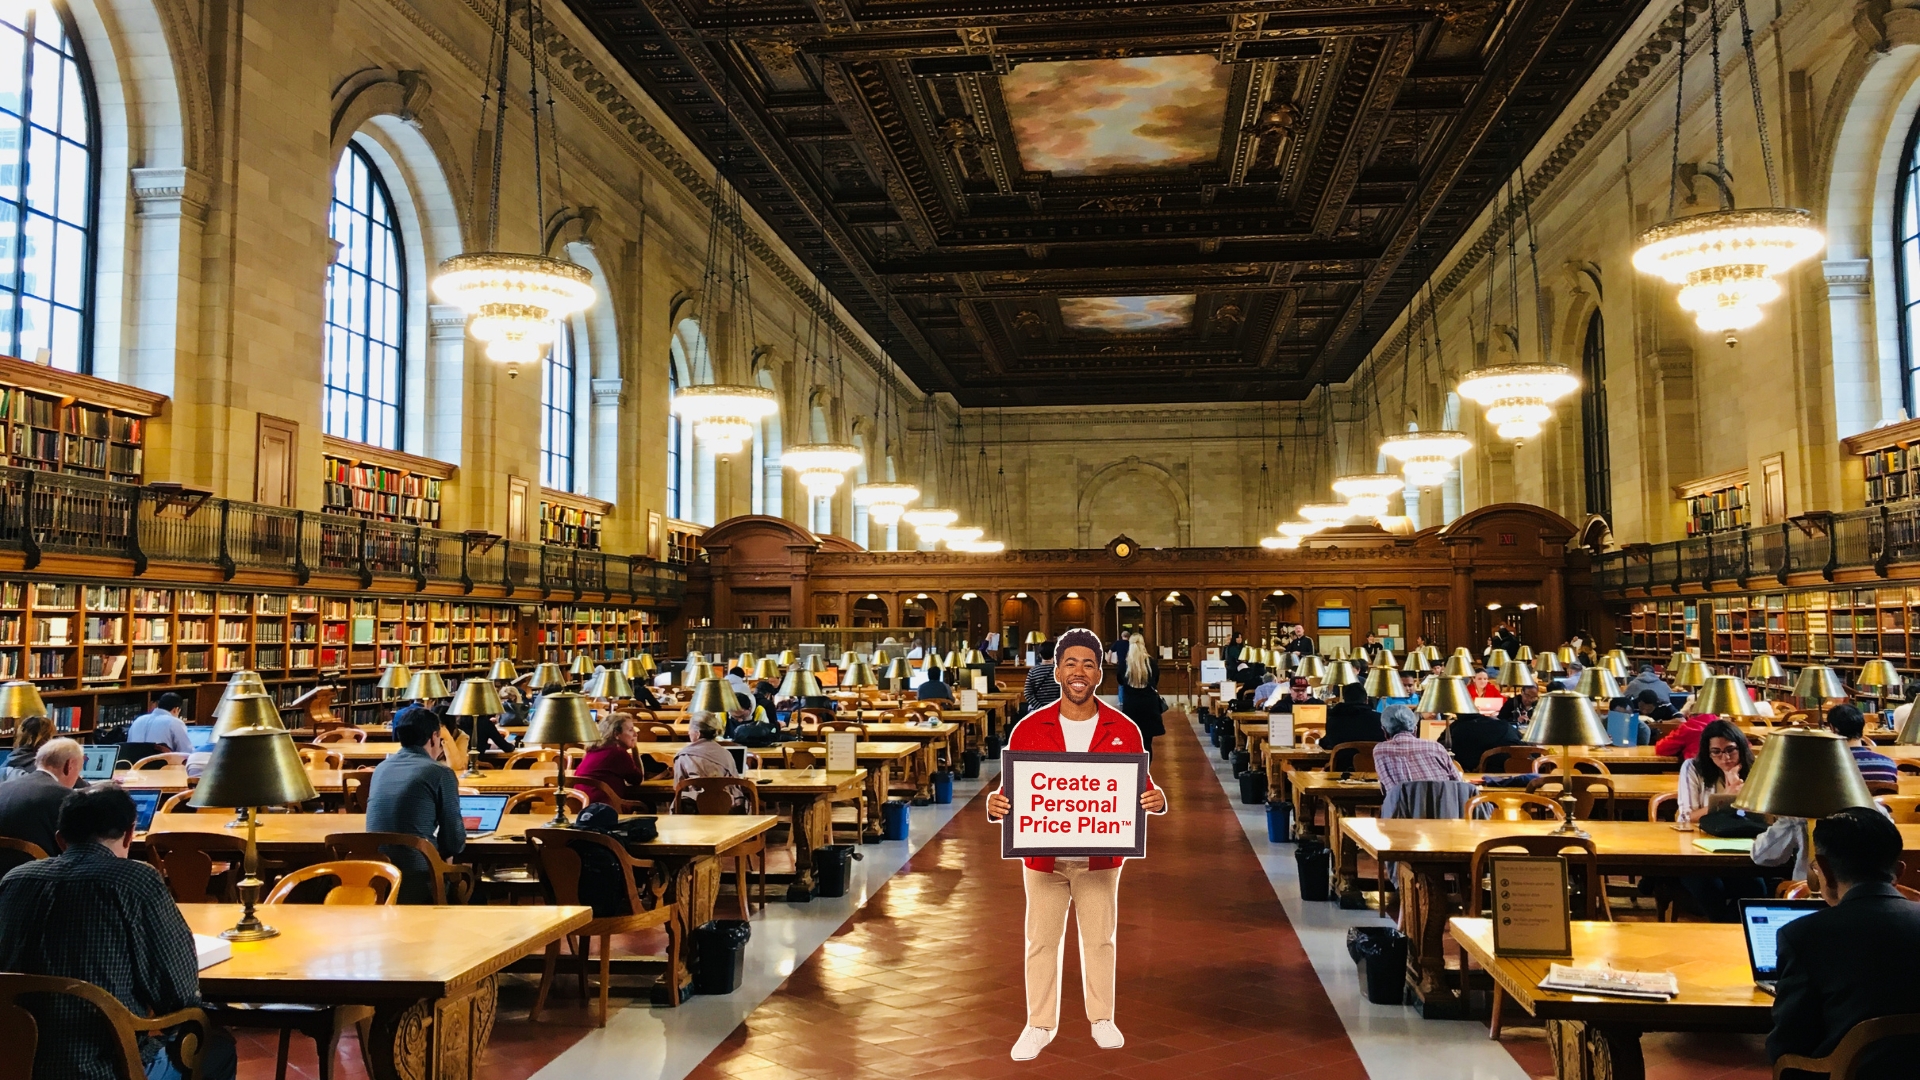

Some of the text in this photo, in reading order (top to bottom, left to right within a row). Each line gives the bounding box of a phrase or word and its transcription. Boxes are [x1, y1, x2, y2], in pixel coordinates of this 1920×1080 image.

[1499, 534, 1515, 545] EXIT
[1031, 772, 1117, 791] Create a
[1031, 794, 1117, 813] Personal
[1020, 816, 1071, 833] Price
